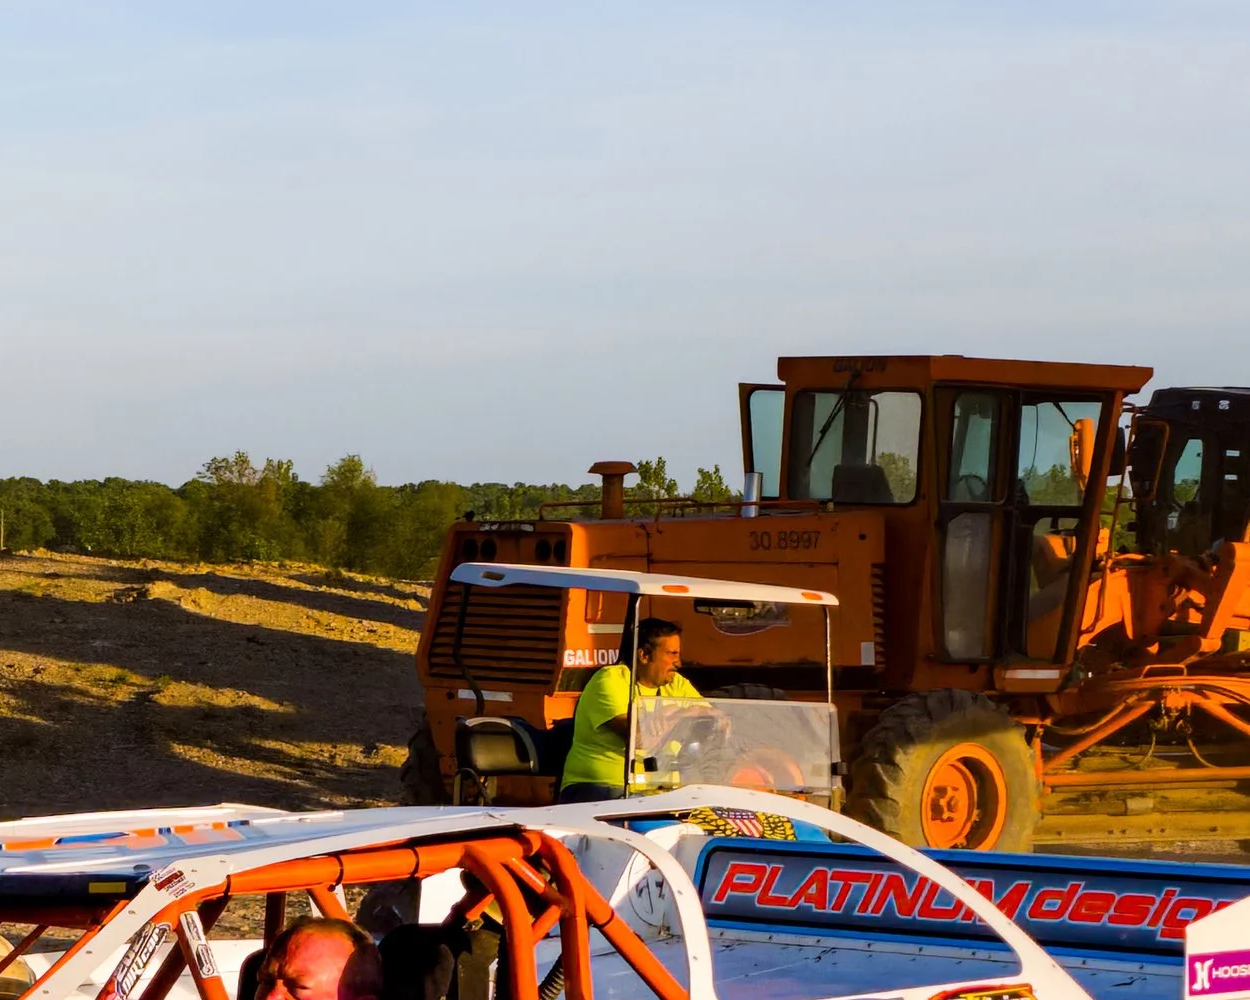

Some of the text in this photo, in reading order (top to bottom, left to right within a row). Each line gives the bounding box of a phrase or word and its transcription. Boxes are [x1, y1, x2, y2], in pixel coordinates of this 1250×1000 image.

[563, 649, 620, 667] GALION
[711, 862, 1234, 940] PLATINUM desig
[1212, 964, 1250, 979] HOOS
